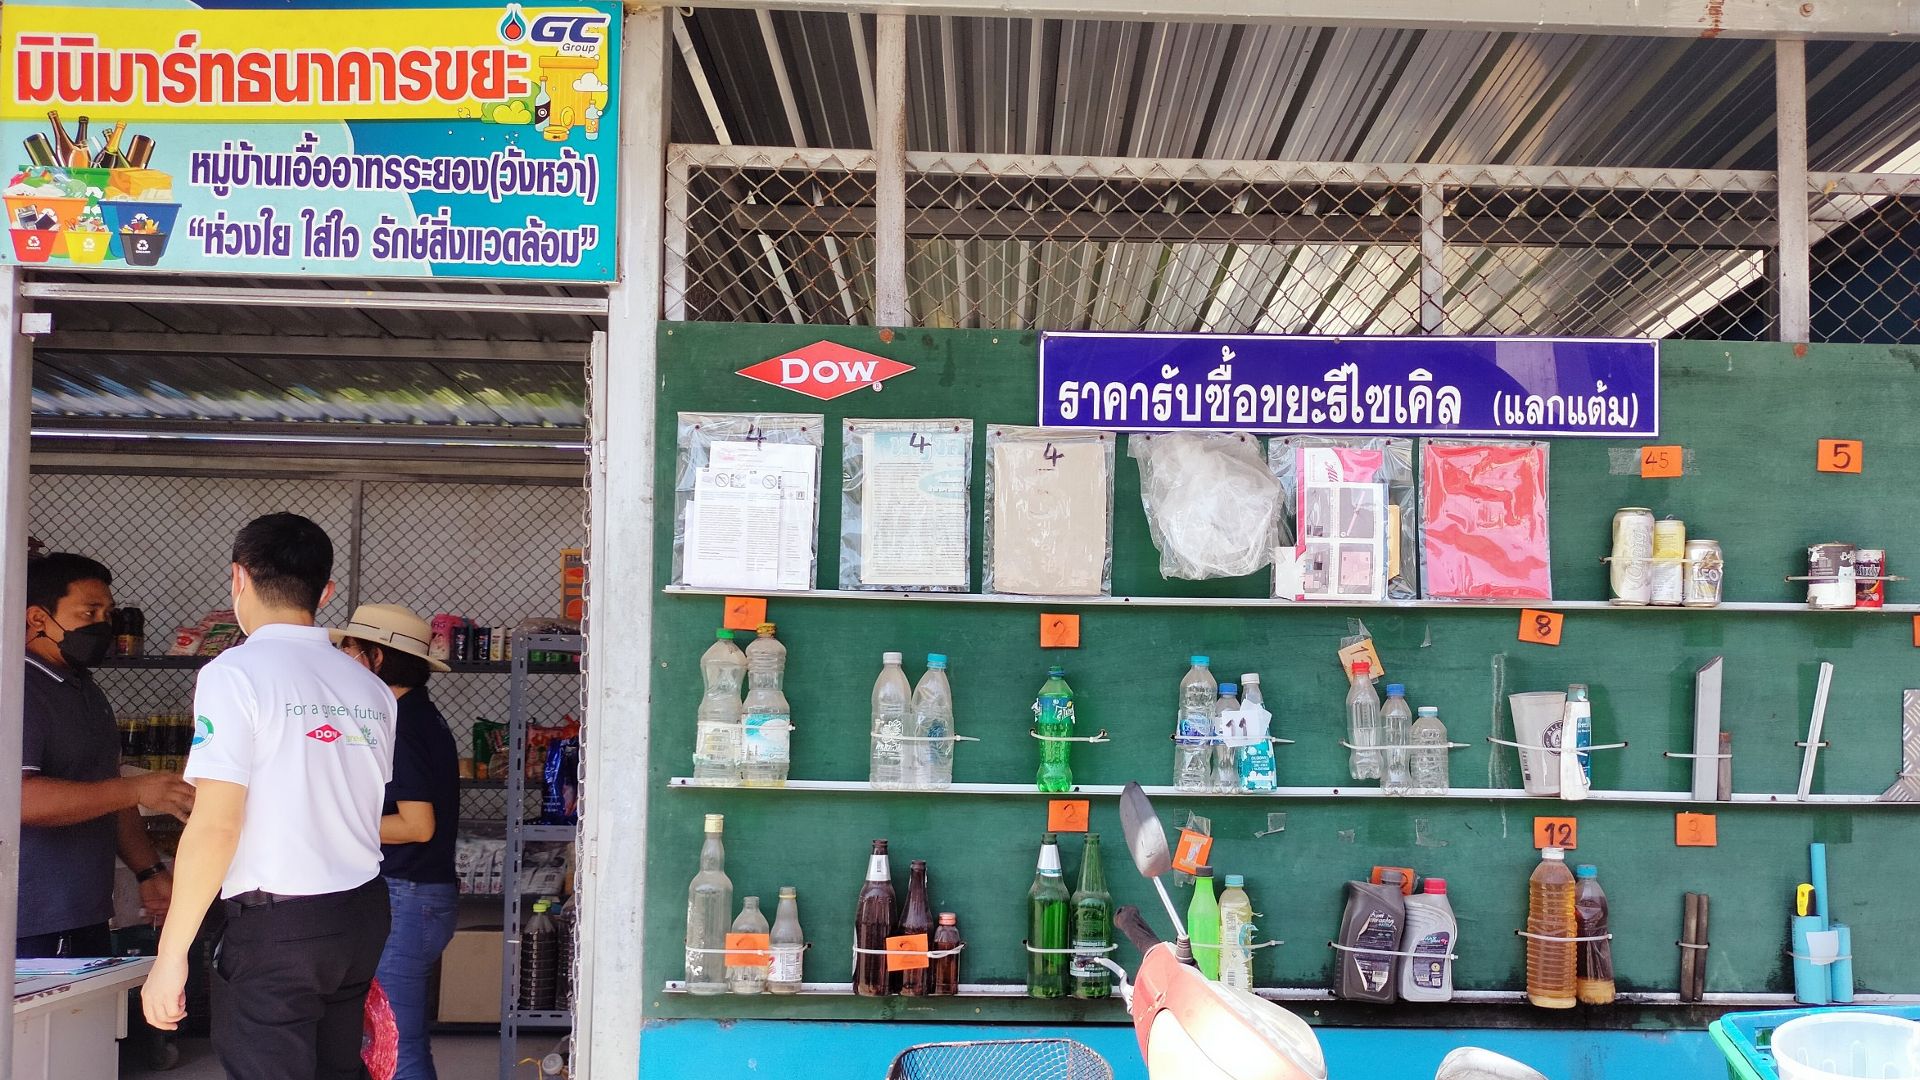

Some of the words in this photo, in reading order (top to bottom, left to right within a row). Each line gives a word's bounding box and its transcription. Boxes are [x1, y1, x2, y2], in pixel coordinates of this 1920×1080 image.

[530, 15, 607, 44] GC
[562, 42, 597, 54] Group
[17, 33, 531, 104] มินิมาร์ทธนาคารขยะ
[190, 132, 598, 202] หมู่บ้านเอื้ออาทรระยอง(วังหว้า)
[301, 209, 360, 258] ใส่ใจ
[780, 358, 880, 385] DOW
[1058, 346, 1462, 425] ราคารับซื้อขยะรีไซเคิล
[1492, 381, 1640, 427] (แลกแต้ม)
[746, 423, 767, 450] 4
[909, 432, 932, 454] 4
[1043, 443, 1065, 467] 4
[1644, 450, 1670, 470] 45
[1832, 444, 1852, 469] 5
[1535, 614, 1552, 638] 8
[285, 703, 307, 718] For
[312, 704, 319, 715] a
[322, 704, 350, 718] green
[354, 704, 387, 722] future
[1225, 716, 1249, 739] 11
[1063, 803, 1078, 824] 2
[1544, 823, 1574, 848] 12
